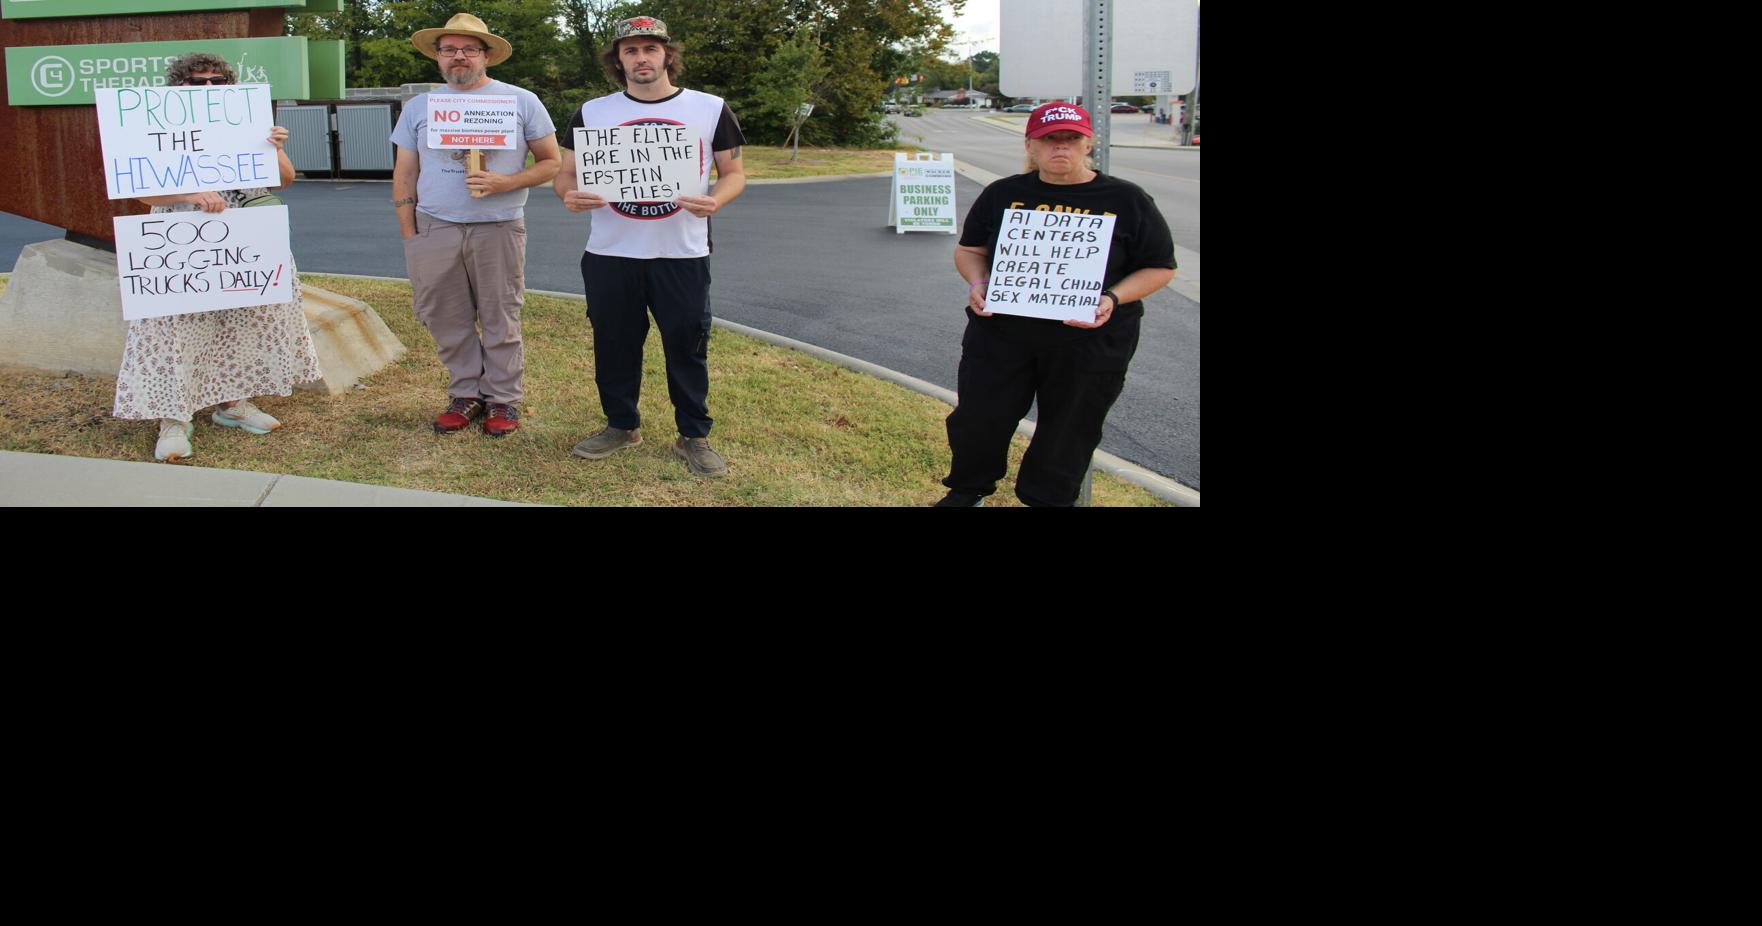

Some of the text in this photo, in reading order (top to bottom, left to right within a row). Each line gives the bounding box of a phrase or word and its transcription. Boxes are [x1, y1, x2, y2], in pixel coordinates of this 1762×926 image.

[80, 76, 166, 93] THERAP
[117, 87, 260, 129] PROTECT
[434, 110, 460, 122] NO
[1040, 113, 1082, 123] TRUMP
[148, 130, 204, 152] THE
[578, 127, 687, 146] THE ELITE
[582, 145, 693, 166] ARE IN THE
[114, 153, 268, 194] HIWASSEE
[582, 165, 662, 186] EPSTEIN
[620, 182, 680, 200] FILES!
[900, 185, 951, 194] BUSINESS
[641, 202, 679, 216] BOTTO
[903, 196, 949, 205] PARKING
[914, 207, 938, 216] ONLY
[1010, 211, 1103, 229] AI DATA
[142, 220, 229, 250] 500
[1008, 228, 1097, 242] CENTERS
[129, 246, 260, 271] LOGGING
[1000, 243, 1099, 259] WILL HELP
[996, 260, 1069, 275] CREATE
[123, 264, 282, 295] TRUCKS DAILY!
[994, 276, 1101, 291] LEGAL CHILD
[990, 290, 1100, 307] SEX MATERIAL
